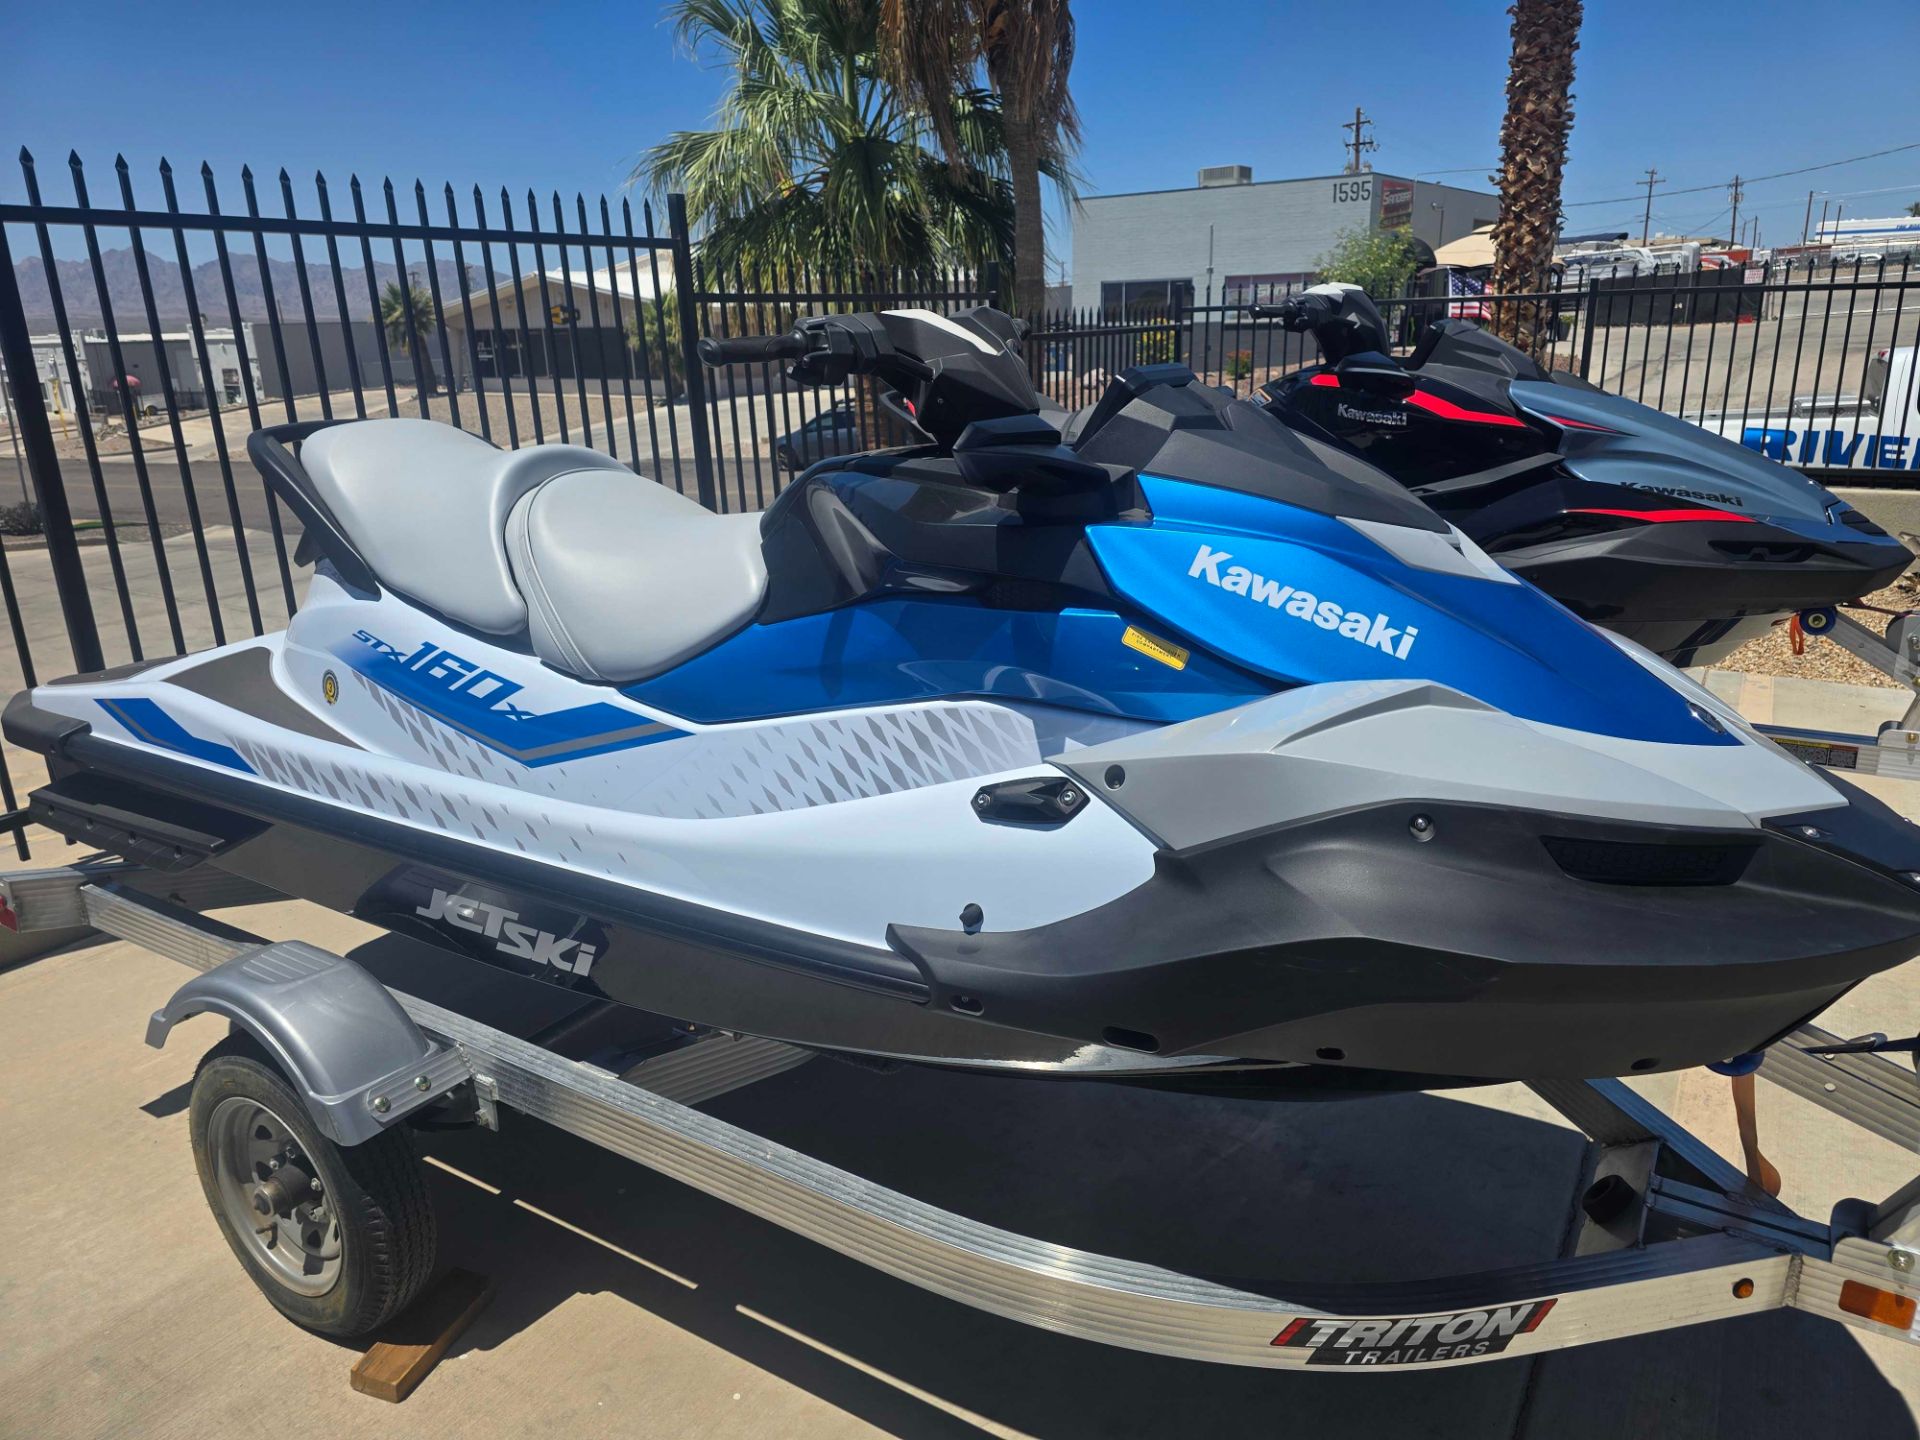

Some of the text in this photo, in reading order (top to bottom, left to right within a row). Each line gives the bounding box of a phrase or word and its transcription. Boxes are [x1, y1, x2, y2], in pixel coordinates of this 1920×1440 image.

[1333, 181, 1371, 203] 1595
[1337, 402, 1408, 426] Kawasaki
[1620, 479, 1744, 508] Kawasaki
[1188, 544, 1418, 661] Kawasaki
[352, 630, 408, 664] STX
[410, 640, 526, 711] 160
[1306, 1302, 1534, 1348] TRITON
[1344, 1341, 1489, 1366] TRAILERS
